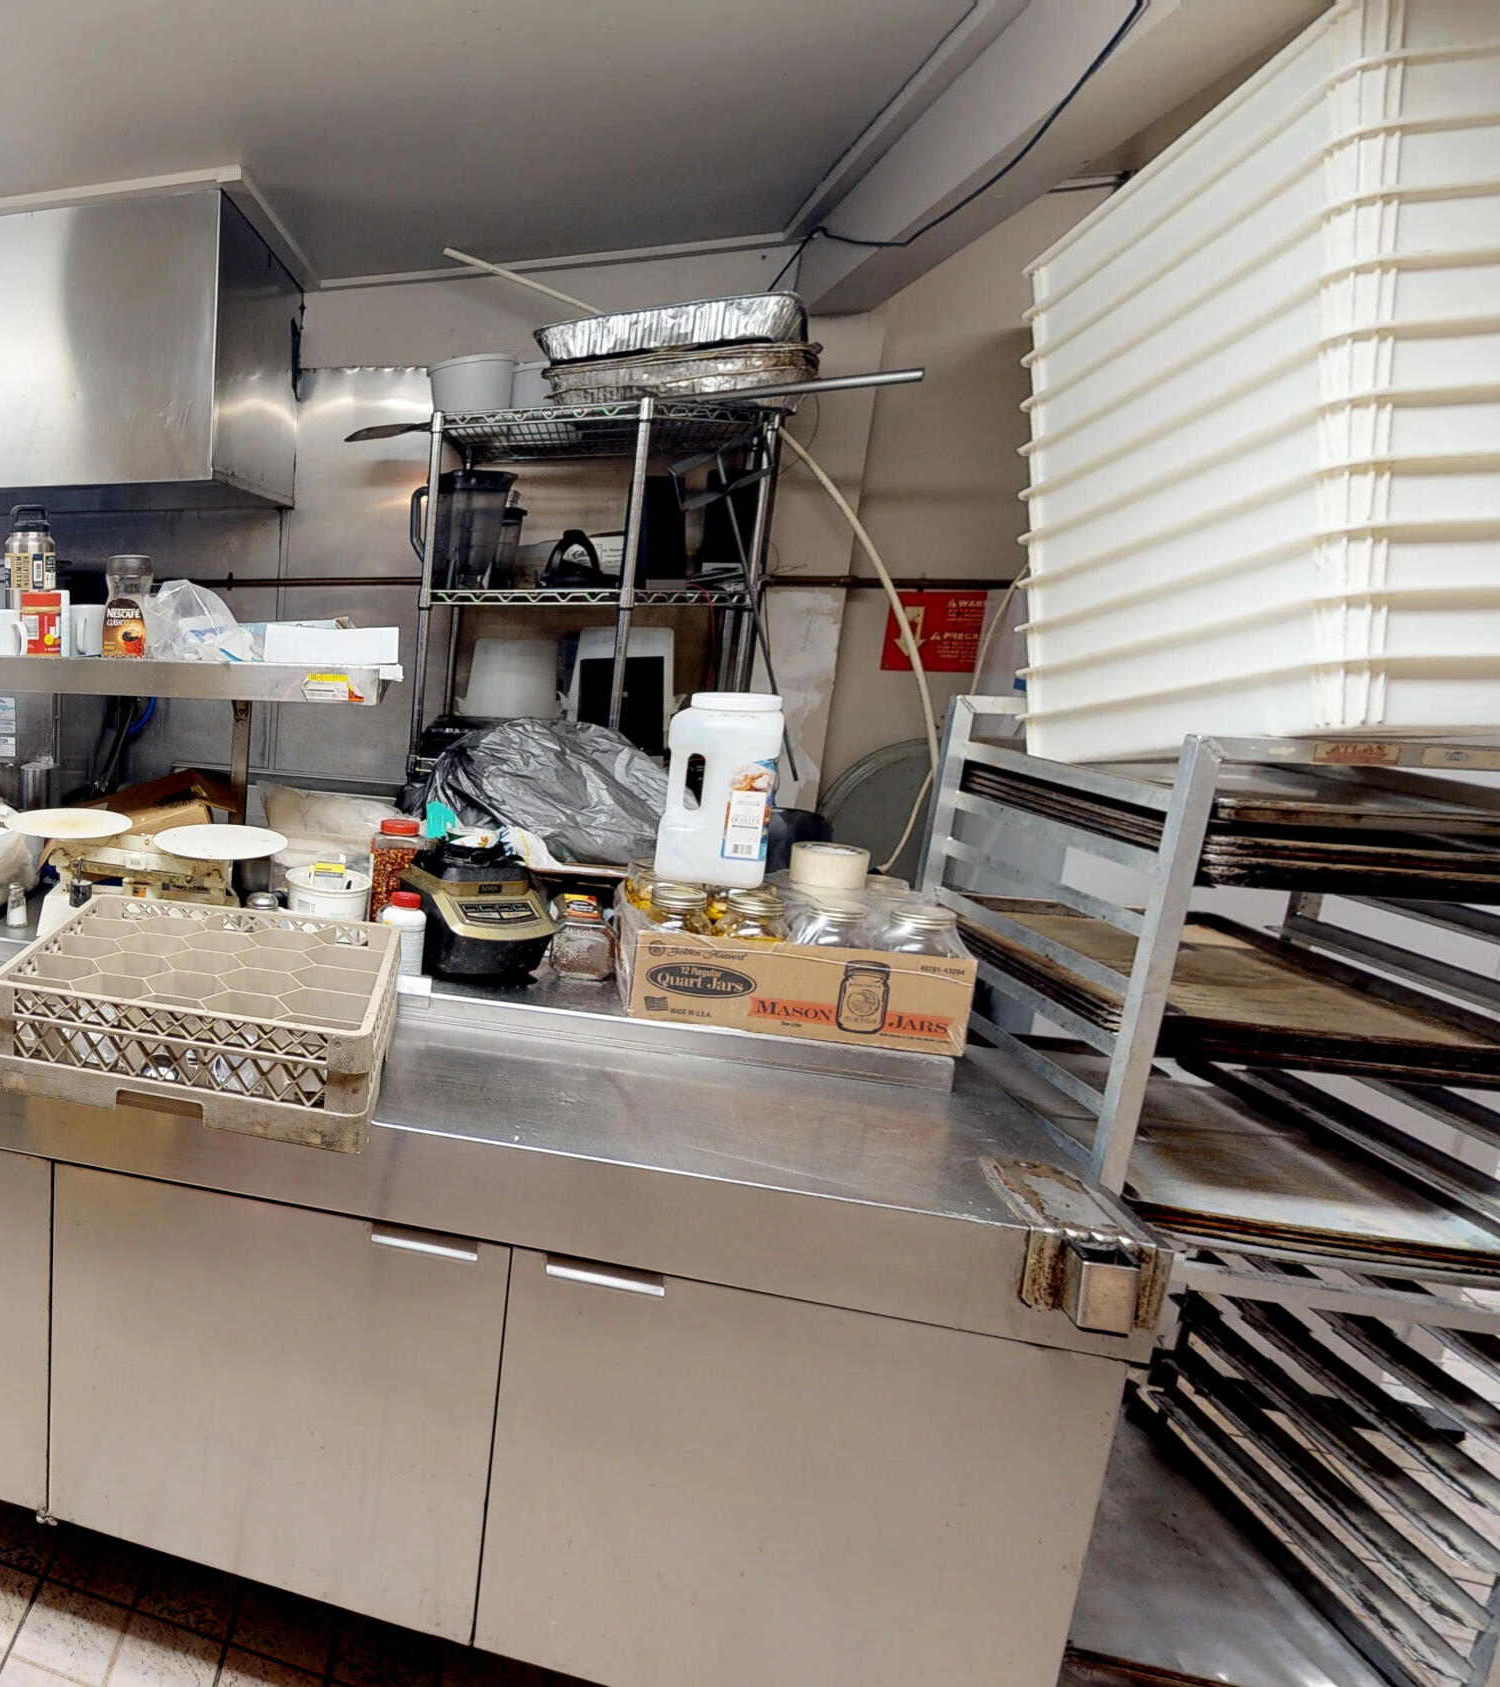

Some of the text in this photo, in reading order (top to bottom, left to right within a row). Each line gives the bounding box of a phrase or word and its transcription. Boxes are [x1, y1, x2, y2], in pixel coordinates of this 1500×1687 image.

[107, 608, 141, 619] NESCAFÉ
[680, 966, 723, 978] 12 Regular
[657, 972, 744, 993] Quart Jars
[756, 1000, 832, 1021] MASON
[888, 1014, 949, 1034] JARS
